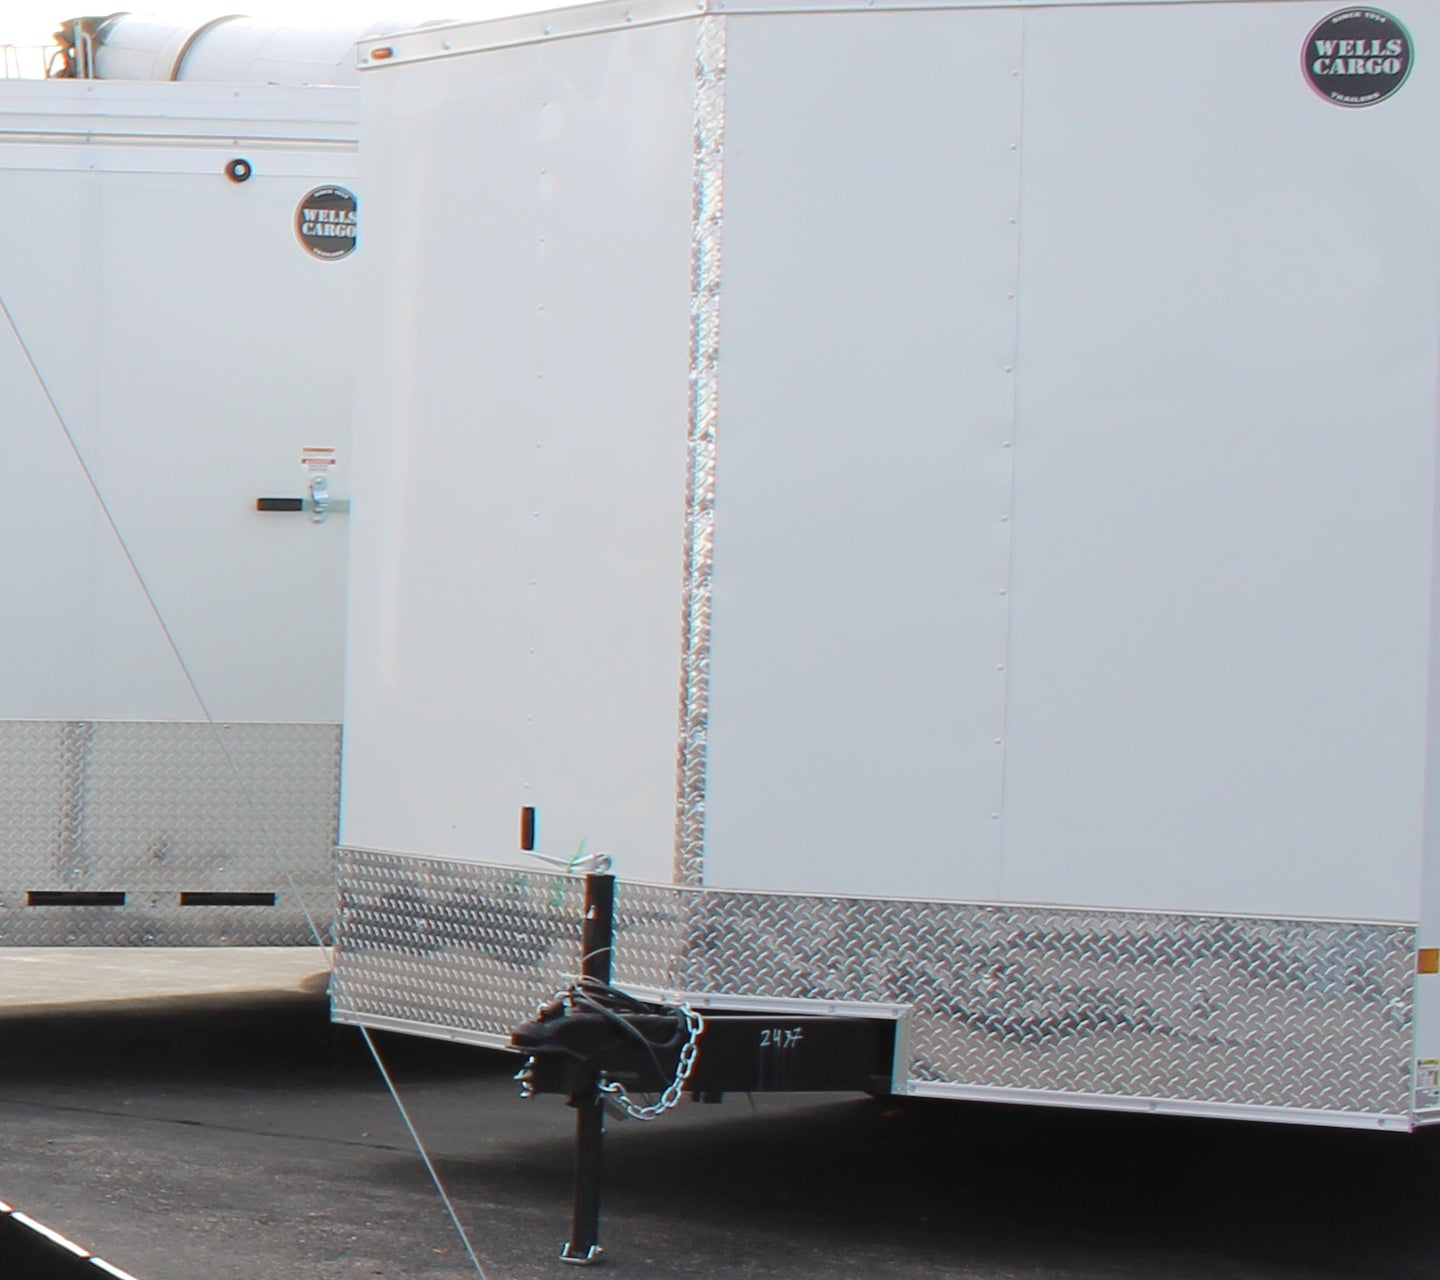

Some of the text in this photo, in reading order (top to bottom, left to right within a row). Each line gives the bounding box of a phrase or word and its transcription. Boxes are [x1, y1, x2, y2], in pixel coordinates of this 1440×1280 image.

[1314, 39, 1402, 57] WELLS
[1312, 57, 1401, 75] CARGO
[303, 209, 358, 224] WELLS
[302, 222, 357, 238] CARGO
[760, 1027, 804, 1049] 2437
